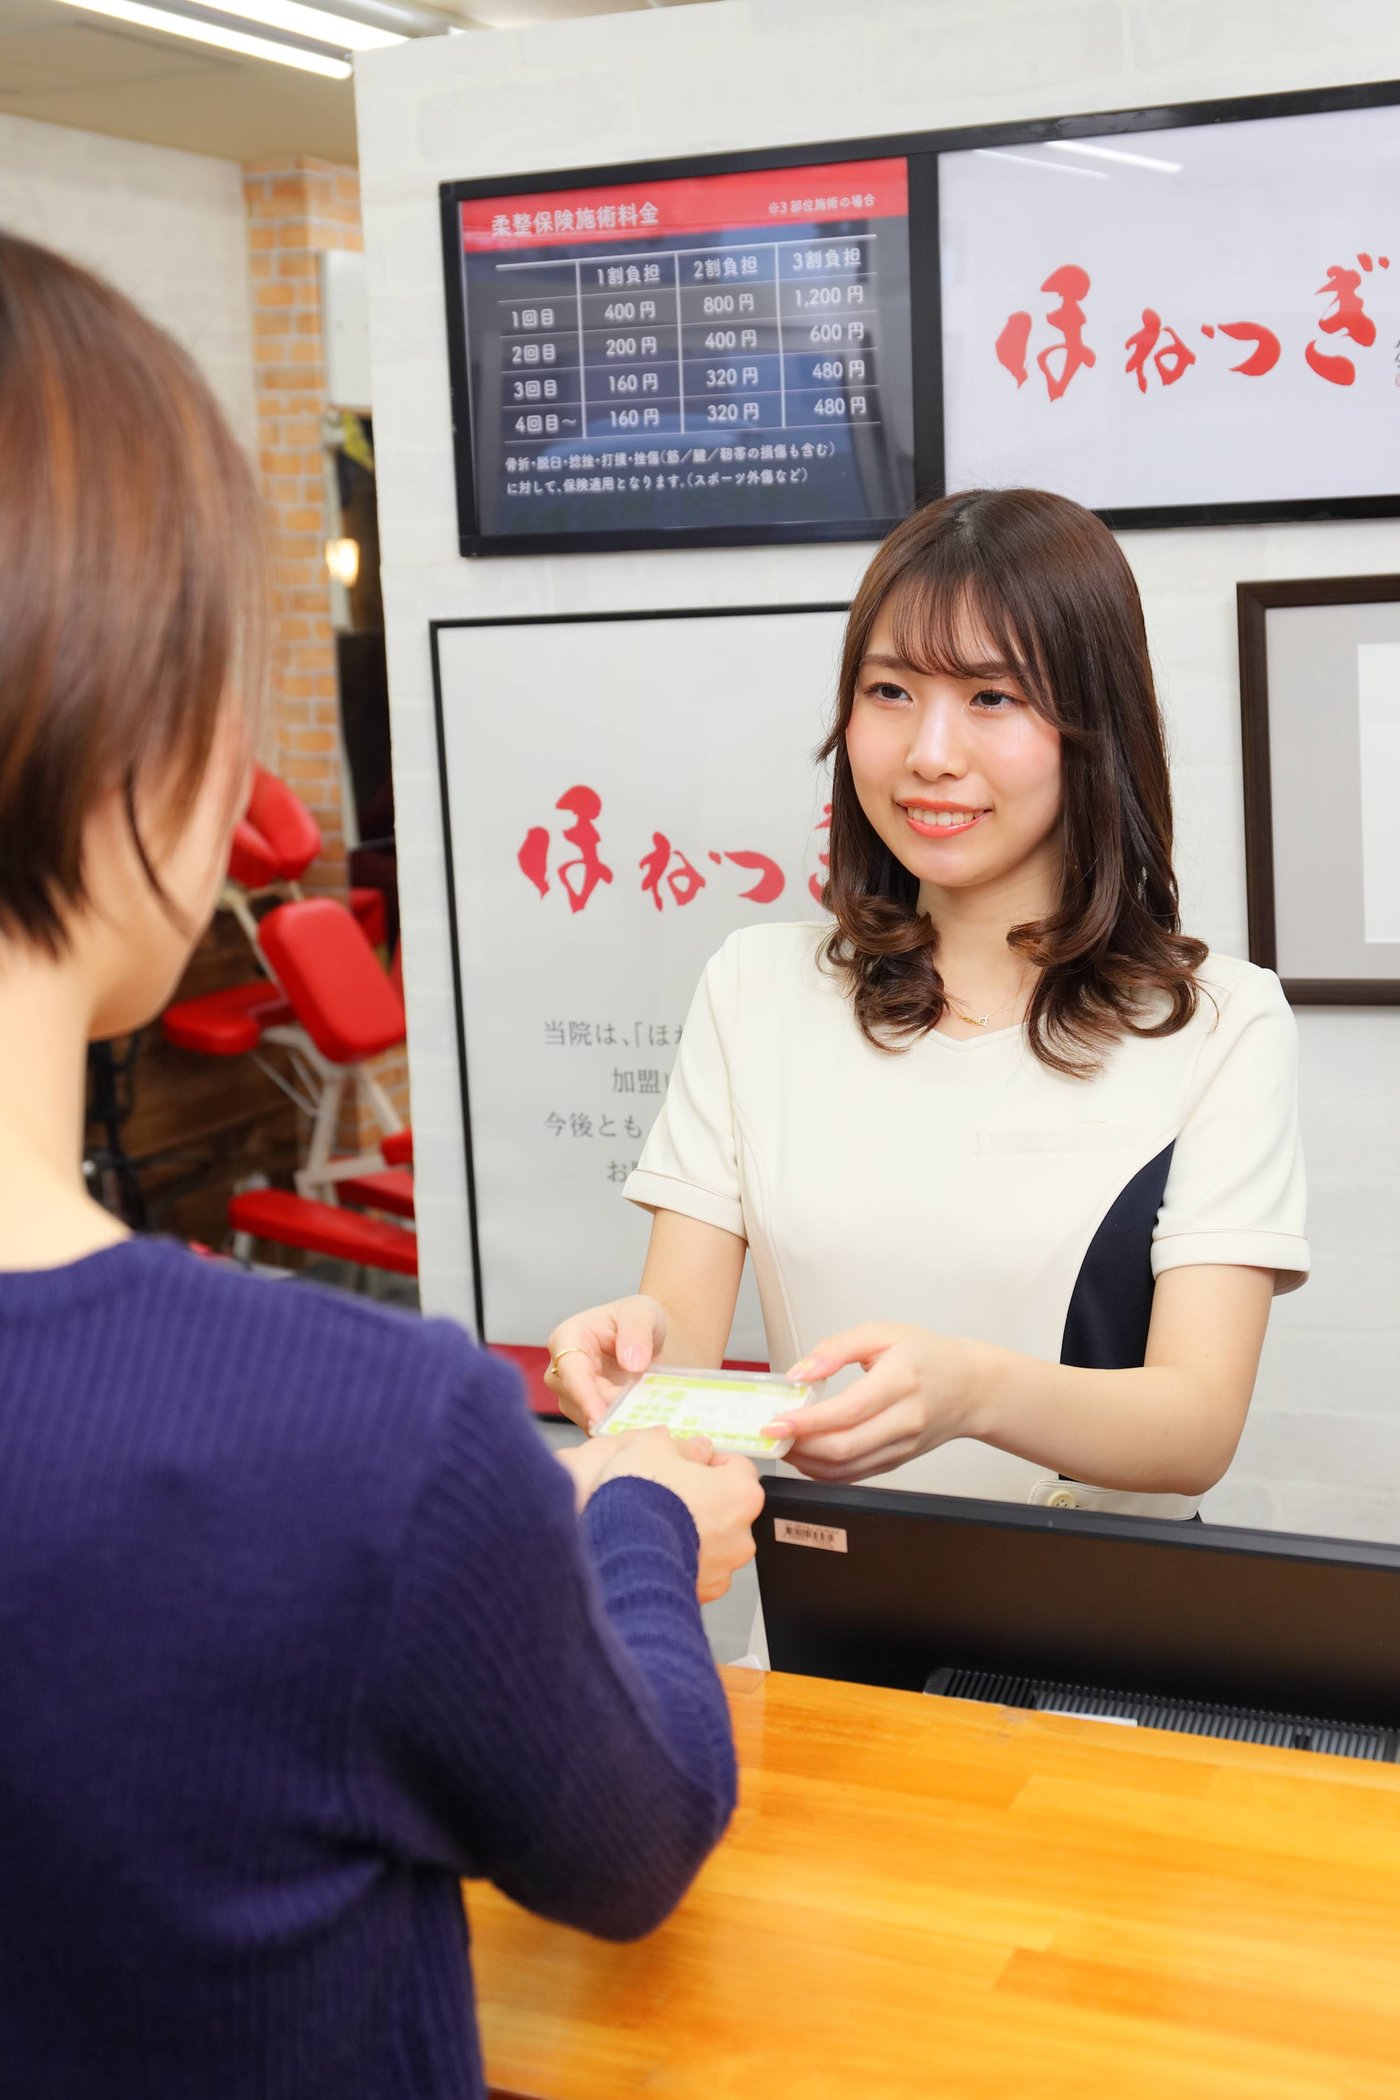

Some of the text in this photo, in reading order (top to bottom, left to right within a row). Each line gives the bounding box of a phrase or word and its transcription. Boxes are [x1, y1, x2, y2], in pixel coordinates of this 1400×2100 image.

[491, 202, 659, 236] 柔整保険施術料金
[693, 256, 758, 279] 2割負担
[792, 248, 861, 270] 3割負担
[597, 264, 660, 285] 1割負担
[512, 308, 554, 328] 1回目
[995, 252, 1390, 403] ほねつぎ
[512, 343, 556, 364] 2回目
[513, 379, 557, 398] 3回目
[517, 785, 833, 914] ほねつ
[607, 1160, 638, 1183] お
